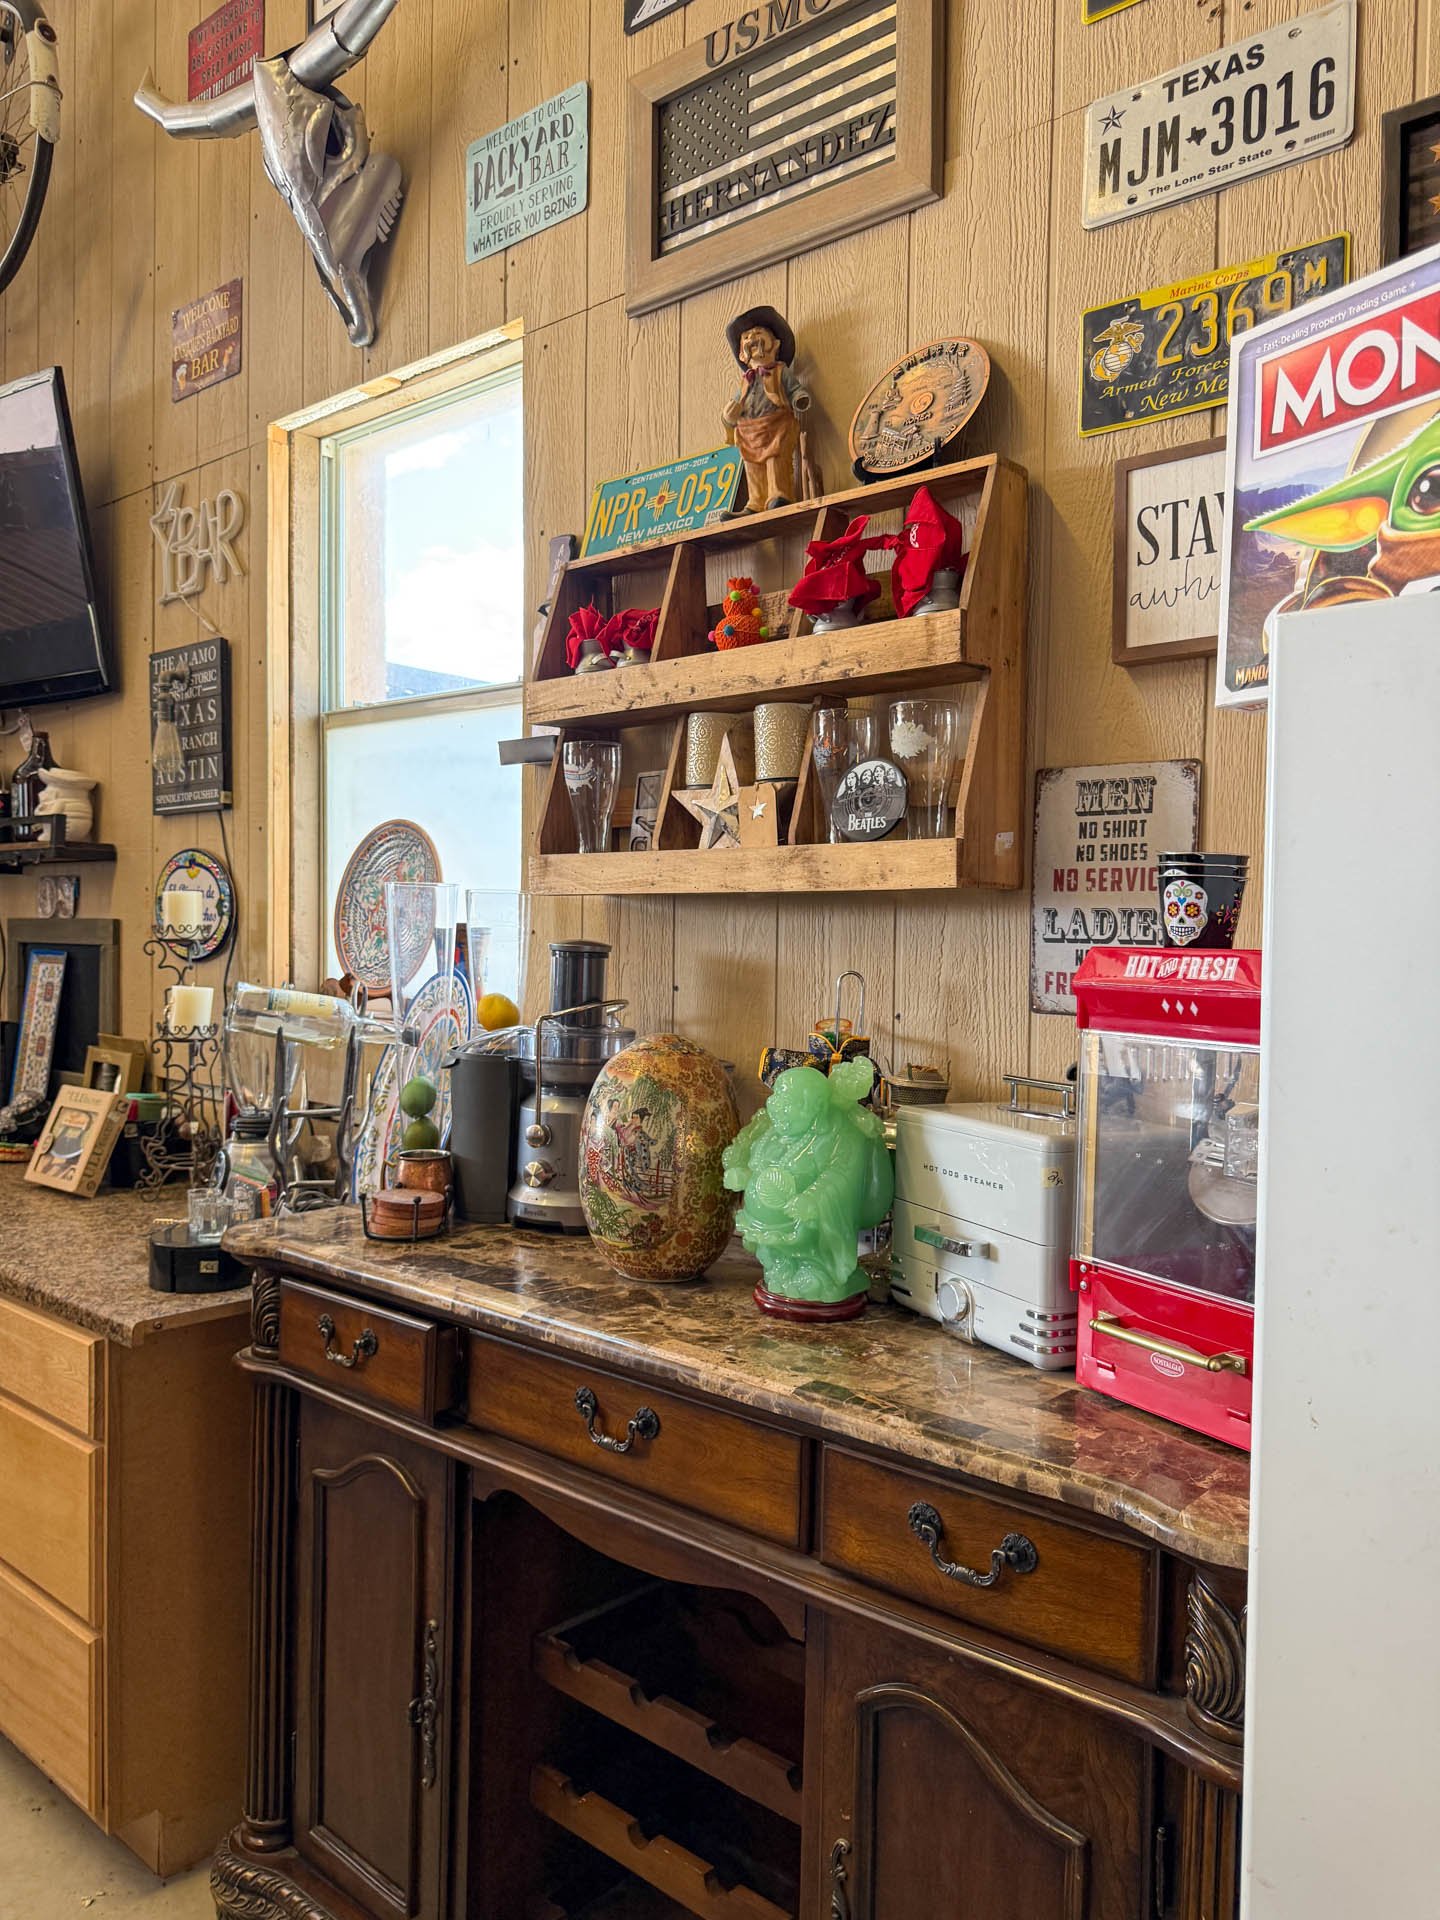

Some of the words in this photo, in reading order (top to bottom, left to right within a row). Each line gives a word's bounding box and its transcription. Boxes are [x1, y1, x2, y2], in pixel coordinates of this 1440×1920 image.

[208, 20, 248, 60] LISTENING
[201, 57, 225, 84] GREAT
[227, 37, 253, 65] MUSIC
[1162, 43, 1265, 103] TEXAS
[486, 116, 529, 151] WELCOME
[533, 108, 544, 126] TO
[547, 96, 566, 116] OUR
[1099, 114, 1181, 198] MJM
[1211, 57, 1336, 156] 3016
[473, 113, 574, 213] BACKYARD
[529, 140, 569, 186] BAR
[664, 104, 895, 231] HERNANDEZ
[1149, 185, 1171, 197] The
[1174, 171, 1204, 187] Lone
[1208, 160, 1234, 176] Star
[1238, 148, 1272, 166] State
[473, 219, 521, 254] WHATEVER
[523, 211, 541, 233] YOU
[544, 192, 577, 221] BRING
[480, 200, 524, 232] PROUDLY
[528, 175, 573, 208] SERVING
[1169, 279, 1211, 299] Marine
[1215, 269, 1250, 287] Corps
[182, 291, 231, 331] WELCOME
[1263, 325, 1310, 353] Fast-Dealing
[1310, 309, 1348, 333] Property
[1348, 295, 1380, 317] Trading
[1380, 285, 1408, 302] Game
[191, 348, 220, 380] BAR
[1099, 376, 1160, 400] Armed
[1168, 358, 1230, 384] Forces
[1140, 388, 1189, 411] New
[1193, 376, 1230, 398] Me
[631, 468, 673, 486] CENTENNIAL
[591, 487, 647, 541] NPR
[675, 462, 736, 518] 059
[616, 528, 644, 545] NEW
[646, 516, 694, 537] MEXICO
[153, 656, 175, 676] THE
[182, 731, 218, 751] RANCH
[155, 756, 219, 786] AUSTIN
[193, 788, 219, 802] GUSHER
[1075, 776, 1157, 817] MEN
[1078, 821, 1098, 840] NO
[1103, 819, 1148, 839] SHIRT
[1076, 844, 1095, 862] NO
[1100, 843, 1148, 861] SHOES
[1053, 868, 1079, 892] NO
[1042, 907, 1164, 945] LADIE
[1123, 955, 1162, 978] HOT
[1157, 957, 1180, 978] AND
[1177, 956, 1241, 981] FRESH
[923, 1163, 939, 1173] HOT
[942, 1168, 959, 1178] DOG
[963, 1174, 1004, 1191] STEAMER
